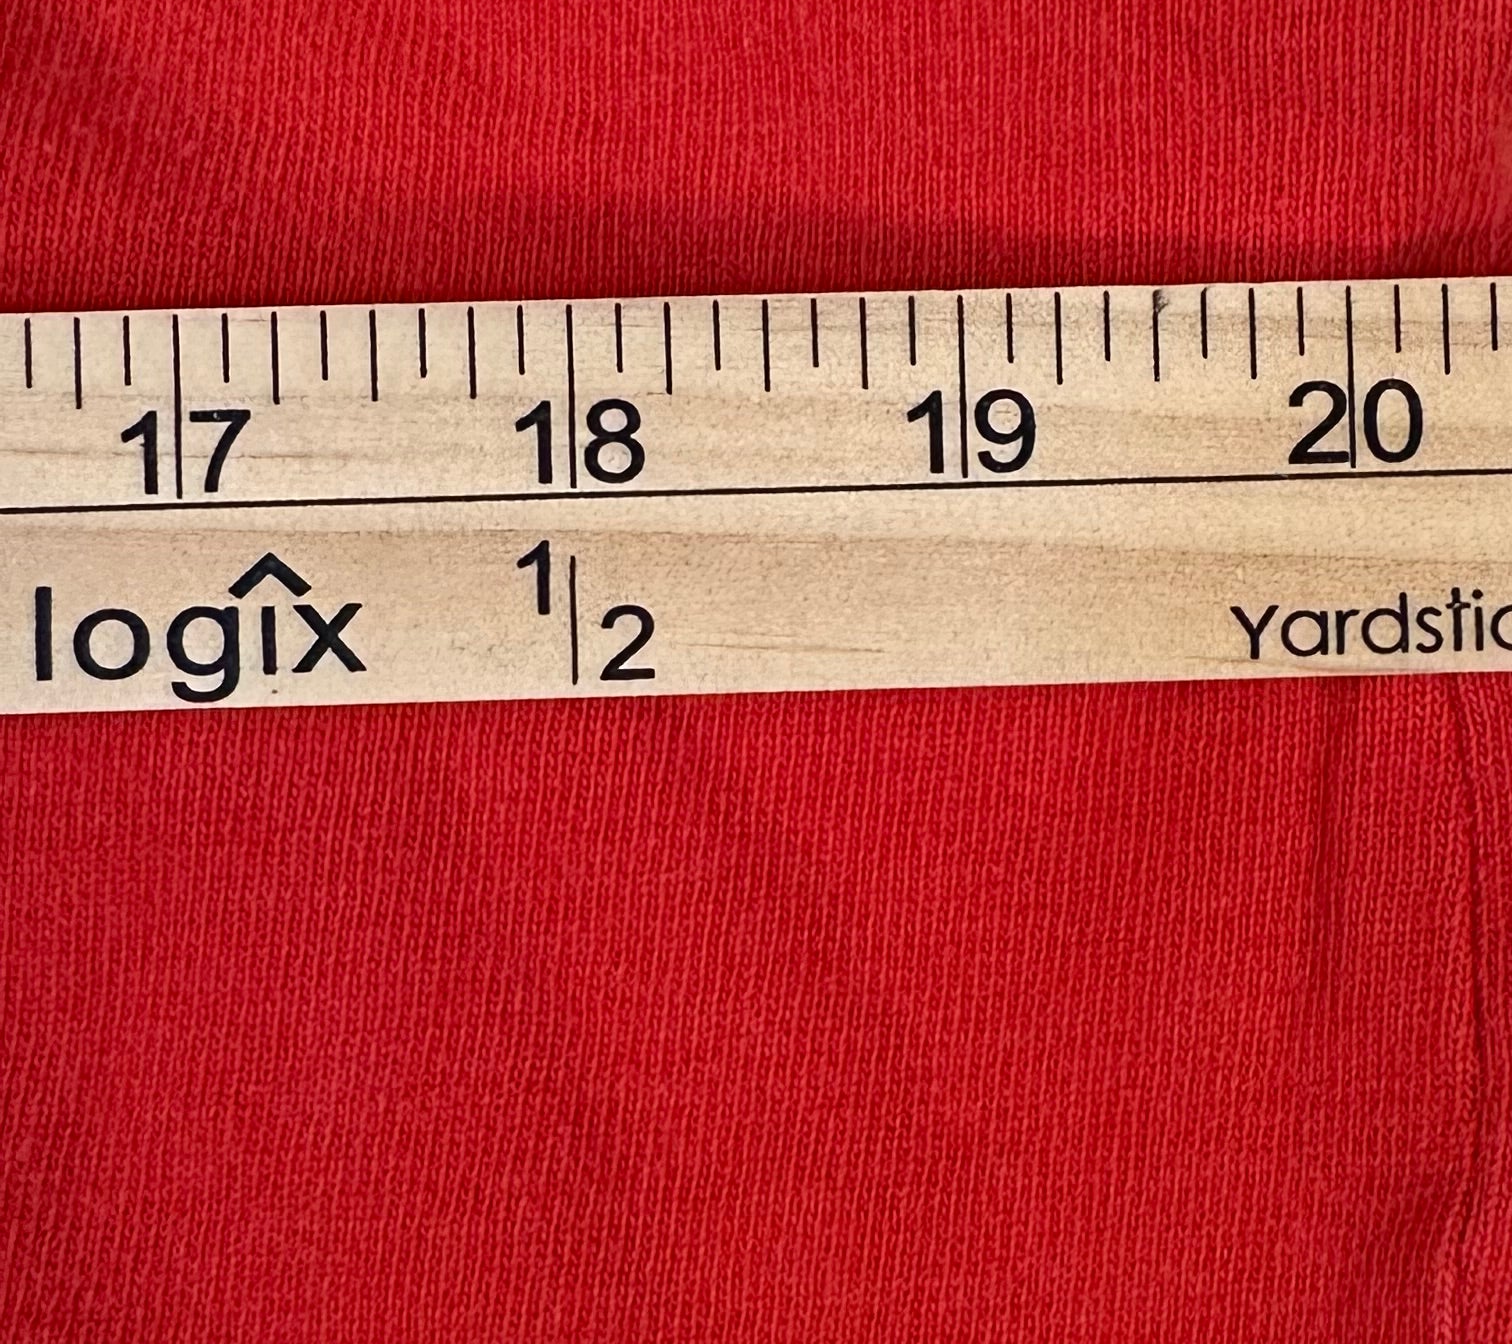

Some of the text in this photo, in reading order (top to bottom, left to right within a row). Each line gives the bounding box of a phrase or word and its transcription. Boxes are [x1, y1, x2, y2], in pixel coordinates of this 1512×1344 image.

[121, 409, 251, 495] 17
[515, 399, 645, 485] 18
[907, 389, 1037, 474] 19
[1288, 378, 1424, 464] 20
